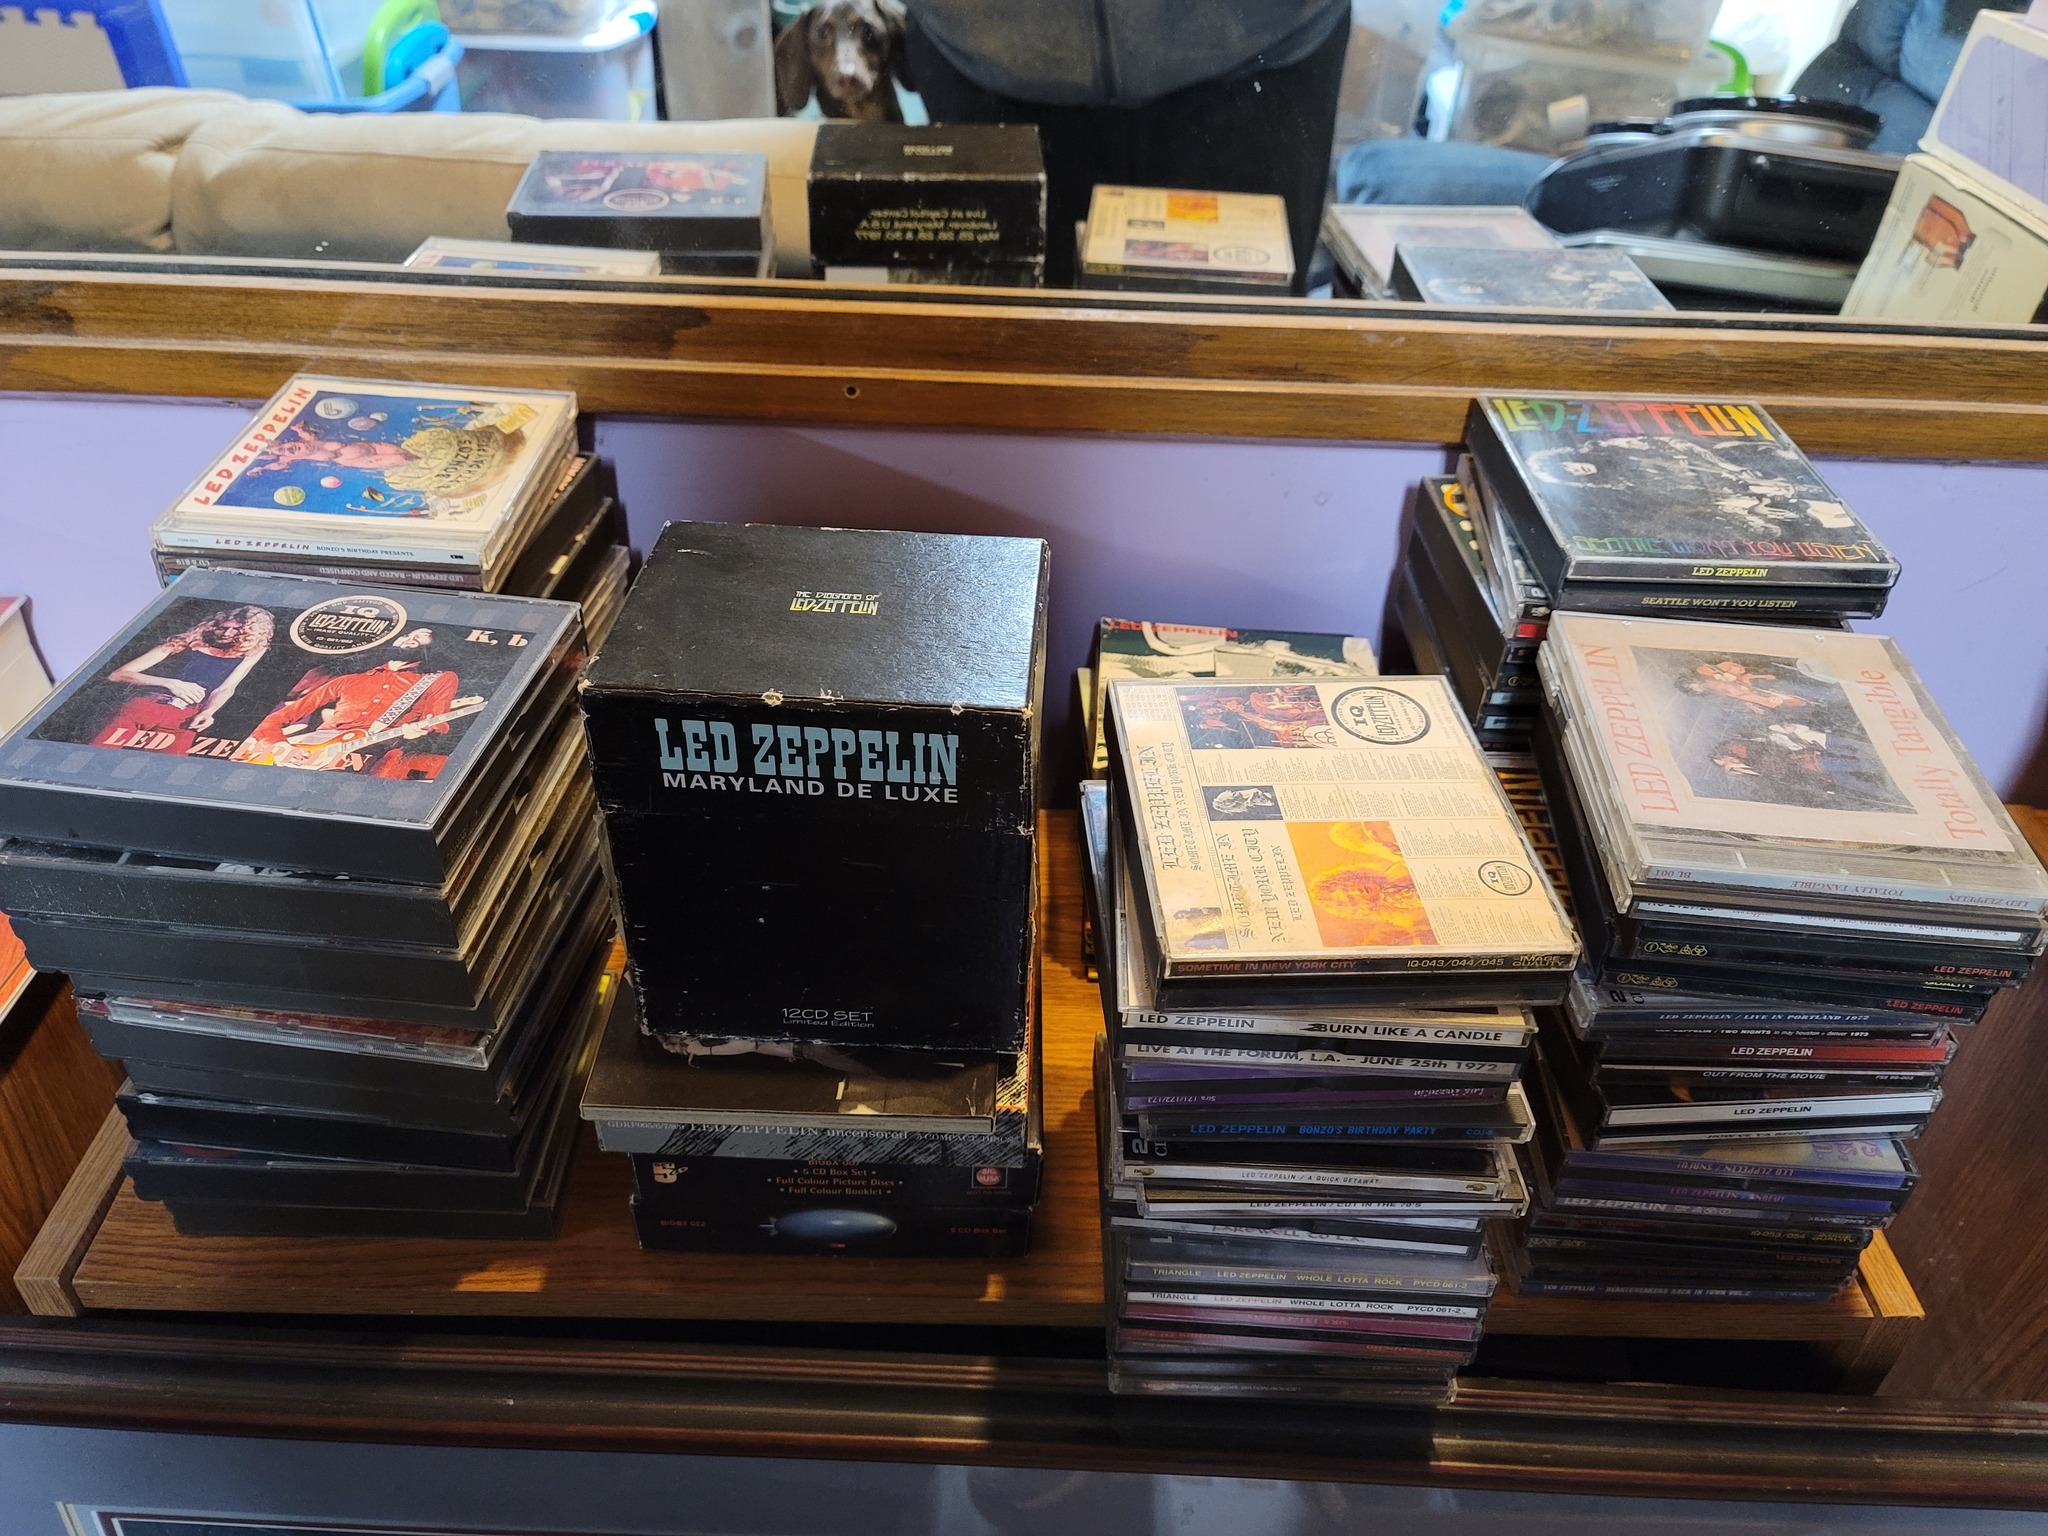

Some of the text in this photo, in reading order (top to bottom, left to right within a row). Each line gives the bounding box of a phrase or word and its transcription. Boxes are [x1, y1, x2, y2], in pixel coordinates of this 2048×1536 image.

[194, 388, 311, 506] LED ZEPPELIN
[215, 538, 242, 546] LED
[246, 540, 310, 550] ZEPPELIN
[346, 547, 379, 555] BIRTHDAY
[381, 549, 414, 557] PRESENTS
[1692, 567, 1769, 577] LED ZEPPELIN
[1641, 596, 1692, 606] SEATTLE
[1731, 598, 1756, 608] YOU
[1758, 599, 1798, 609] LISTEN
[340, 604, 380, 619] IQ
[1349, 705, 1368, 727] IQ
[1580, 642, 1680, 815] LED ZEPPELIN
[103, 727, 177, 751] LED
[654, 718, 959, 787] LED ZEPPELIN
[1856, 669, 1988, 841] Totally Tangible
[662, 771, 959, 804] MARYLAND DE LUXE
[1136, 744, 1174, 831] ZEPPELIN
[1156, 833, 1185, 871] LED
[1790, 880, 1905, 897] TOTALLY TANGIBLE
[1948, 894, 2030, 908] LED ZEPPELIN
[1177, 963, 1241, 973] SOMETIME
[1245, 962, 1259, 971] IN
[1261, 961, 1291, 971] NEW
[1295, 961, 1327, 970] YORK
[1330, 960, 1357, 969] CITY
[1933, 965, 2013, 978] LED ZEPPELIN
[1886, 999, 1964, 1015] LED ZEPPELIN
[781, 1007, 874, 1023] 12CD SET
[782, 1016, 875, 1029] Limited Edition
[1139, 1013, 1168, 1024] LED
[1174, 1015, 1255, 1029] ZEPPELIN
[1373, 1026, 1410, 1037] LIKE
[1414, 1028, 1428, 1038] A
[1433, 1029, 1503, 1041] CANDLE
[1731, 1047, 1813, 1057] LED ZEPPELIN
[1237, 1049, 1304, 1062] FORUM,
[1310, 1053, 1341, 1063] L.A.
[1359, 1056, 1404, 1066] JUNE
[1410, 1059, 1448, 1069] 25th
[1455, 1061, 1498, 1072] 1972
[1729, 1071, 1762, 1079] FROM
[1733, 1106, 1812, 1116] LED ZEPPELIN
[1189, 1124, 1438, 1136] LED ZEPPELIN BONZO'S BIRTHDAY PARTY
[812, 1168, 827, 1176] CD
[829, 1168, 848, 1176] Box
[850, 1168, 868, 1177] Set
[1724, 1165, 1773, 1175] ZEPPELIN
[1775, 1169, 1794, 1177] LED
[775, 1176, 895, 1187] Full Colour Picture Discs
[1258, 1172, 1296, 1180] ZEPPELIN
[1343, 1176, 1380, 1184] GETAWAY
[788, 1186, 883, 1196] Full Colour Booklet
[1563, 1197, 1667, 1212] LED ZEPPELIN
[1152, 1268, 1468, 1289] TRIANGLE LED ZEPPELIN WHOLE LOTTA ROCK PYCD 061-2
[1151, 1292, 1199, 1301] TRIANGLE
[1236, 1296, 1282, 1305] ZEPPELIN
[1289, 1299, 1325, 1307] WHOLE
[1330, 1300, 1361, 1309] LOTTA
[1366, 1302, 1394, 1311] ROCK
[1406, 1305, 1435, 1313] PYCD
[1435, 1306, 1462, 1314] 061-2
